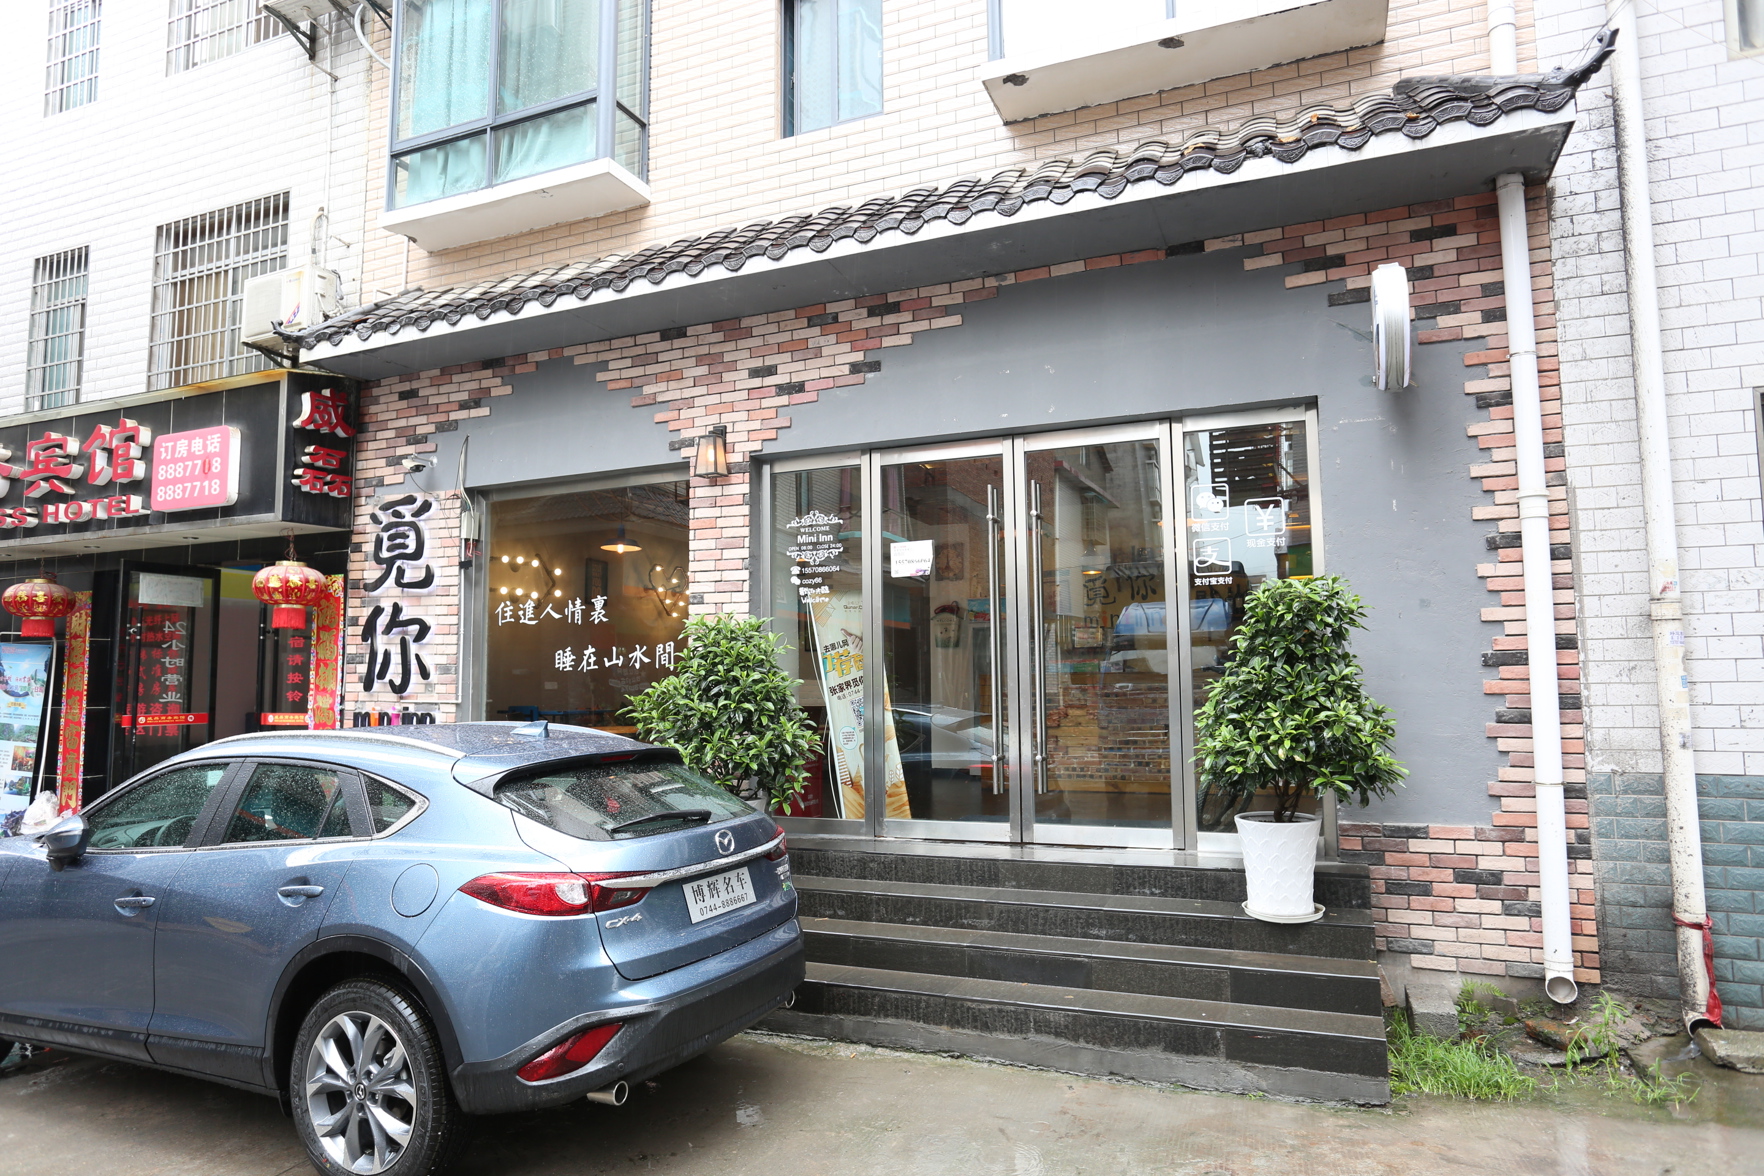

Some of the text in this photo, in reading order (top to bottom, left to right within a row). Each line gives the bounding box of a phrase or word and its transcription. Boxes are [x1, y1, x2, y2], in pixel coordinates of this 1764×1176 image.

[160, 434, 221, 459] 订房电话
[157, 479, 220, 501] 8887718
[43, 495, 146, 524] HOTEL
[797, 533, 834, 544] Mini Inn
[1191, 521, 1229, 532] 微信支付
[1246, 536, 1286, 548] 现金支付
[1194, 576, 1233, 586] 支付宝支付
[361, 495, 434, 694] 覓你
[495, 594, 609, 626] 住進人情裏
[554, 640, 675, 673] 睡在山水間
[691, 871, 748, 905] 博辉名车
[699, 892, 748, 917] 0744-8886667
[605, 912, 643, 929] CX-4
